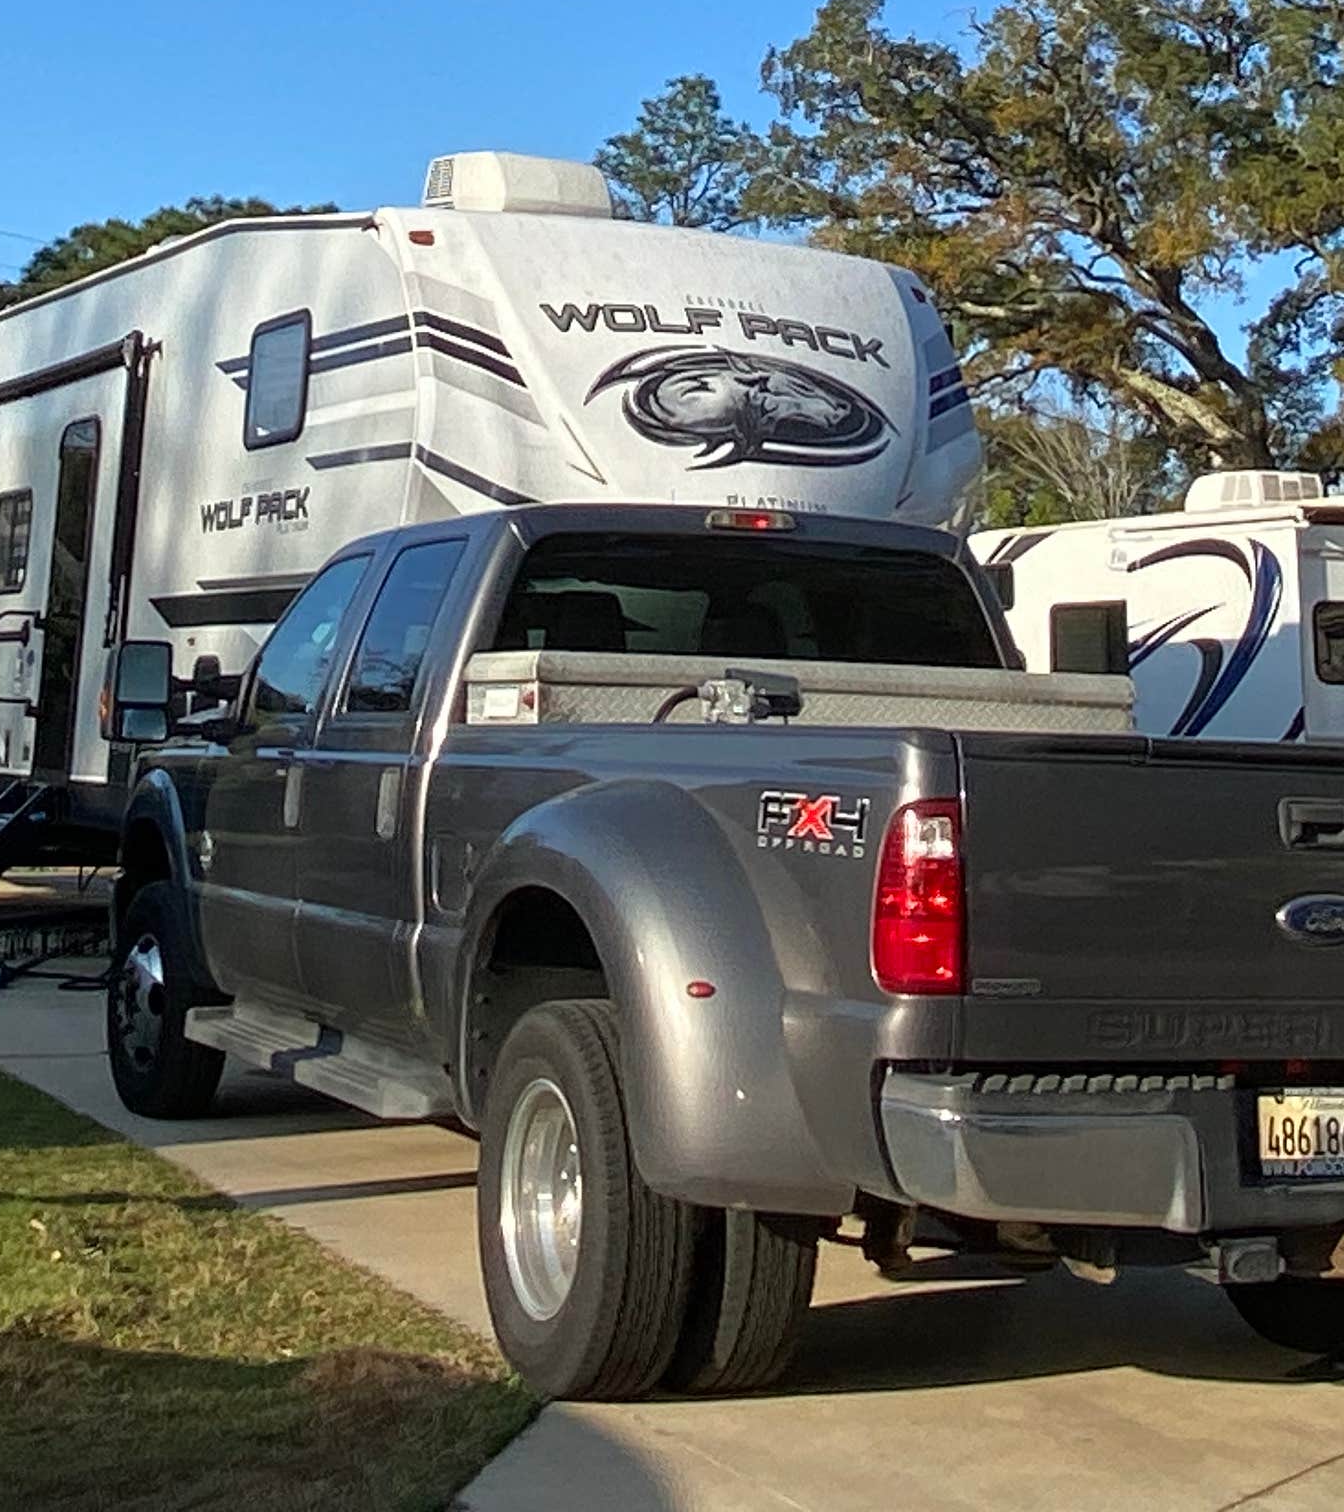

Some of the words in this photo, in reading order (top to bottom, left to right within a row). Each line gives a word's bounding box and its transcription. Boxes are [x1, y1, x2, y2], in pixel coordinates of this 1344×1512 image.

[539, 303, 724, 336] WOLF
[738, 311, 892, 370] PACK
[200, 496, 254, 534] WOLF
[255, 486, 312, 526] PACK
[757, 790, 871, 844] FX4
